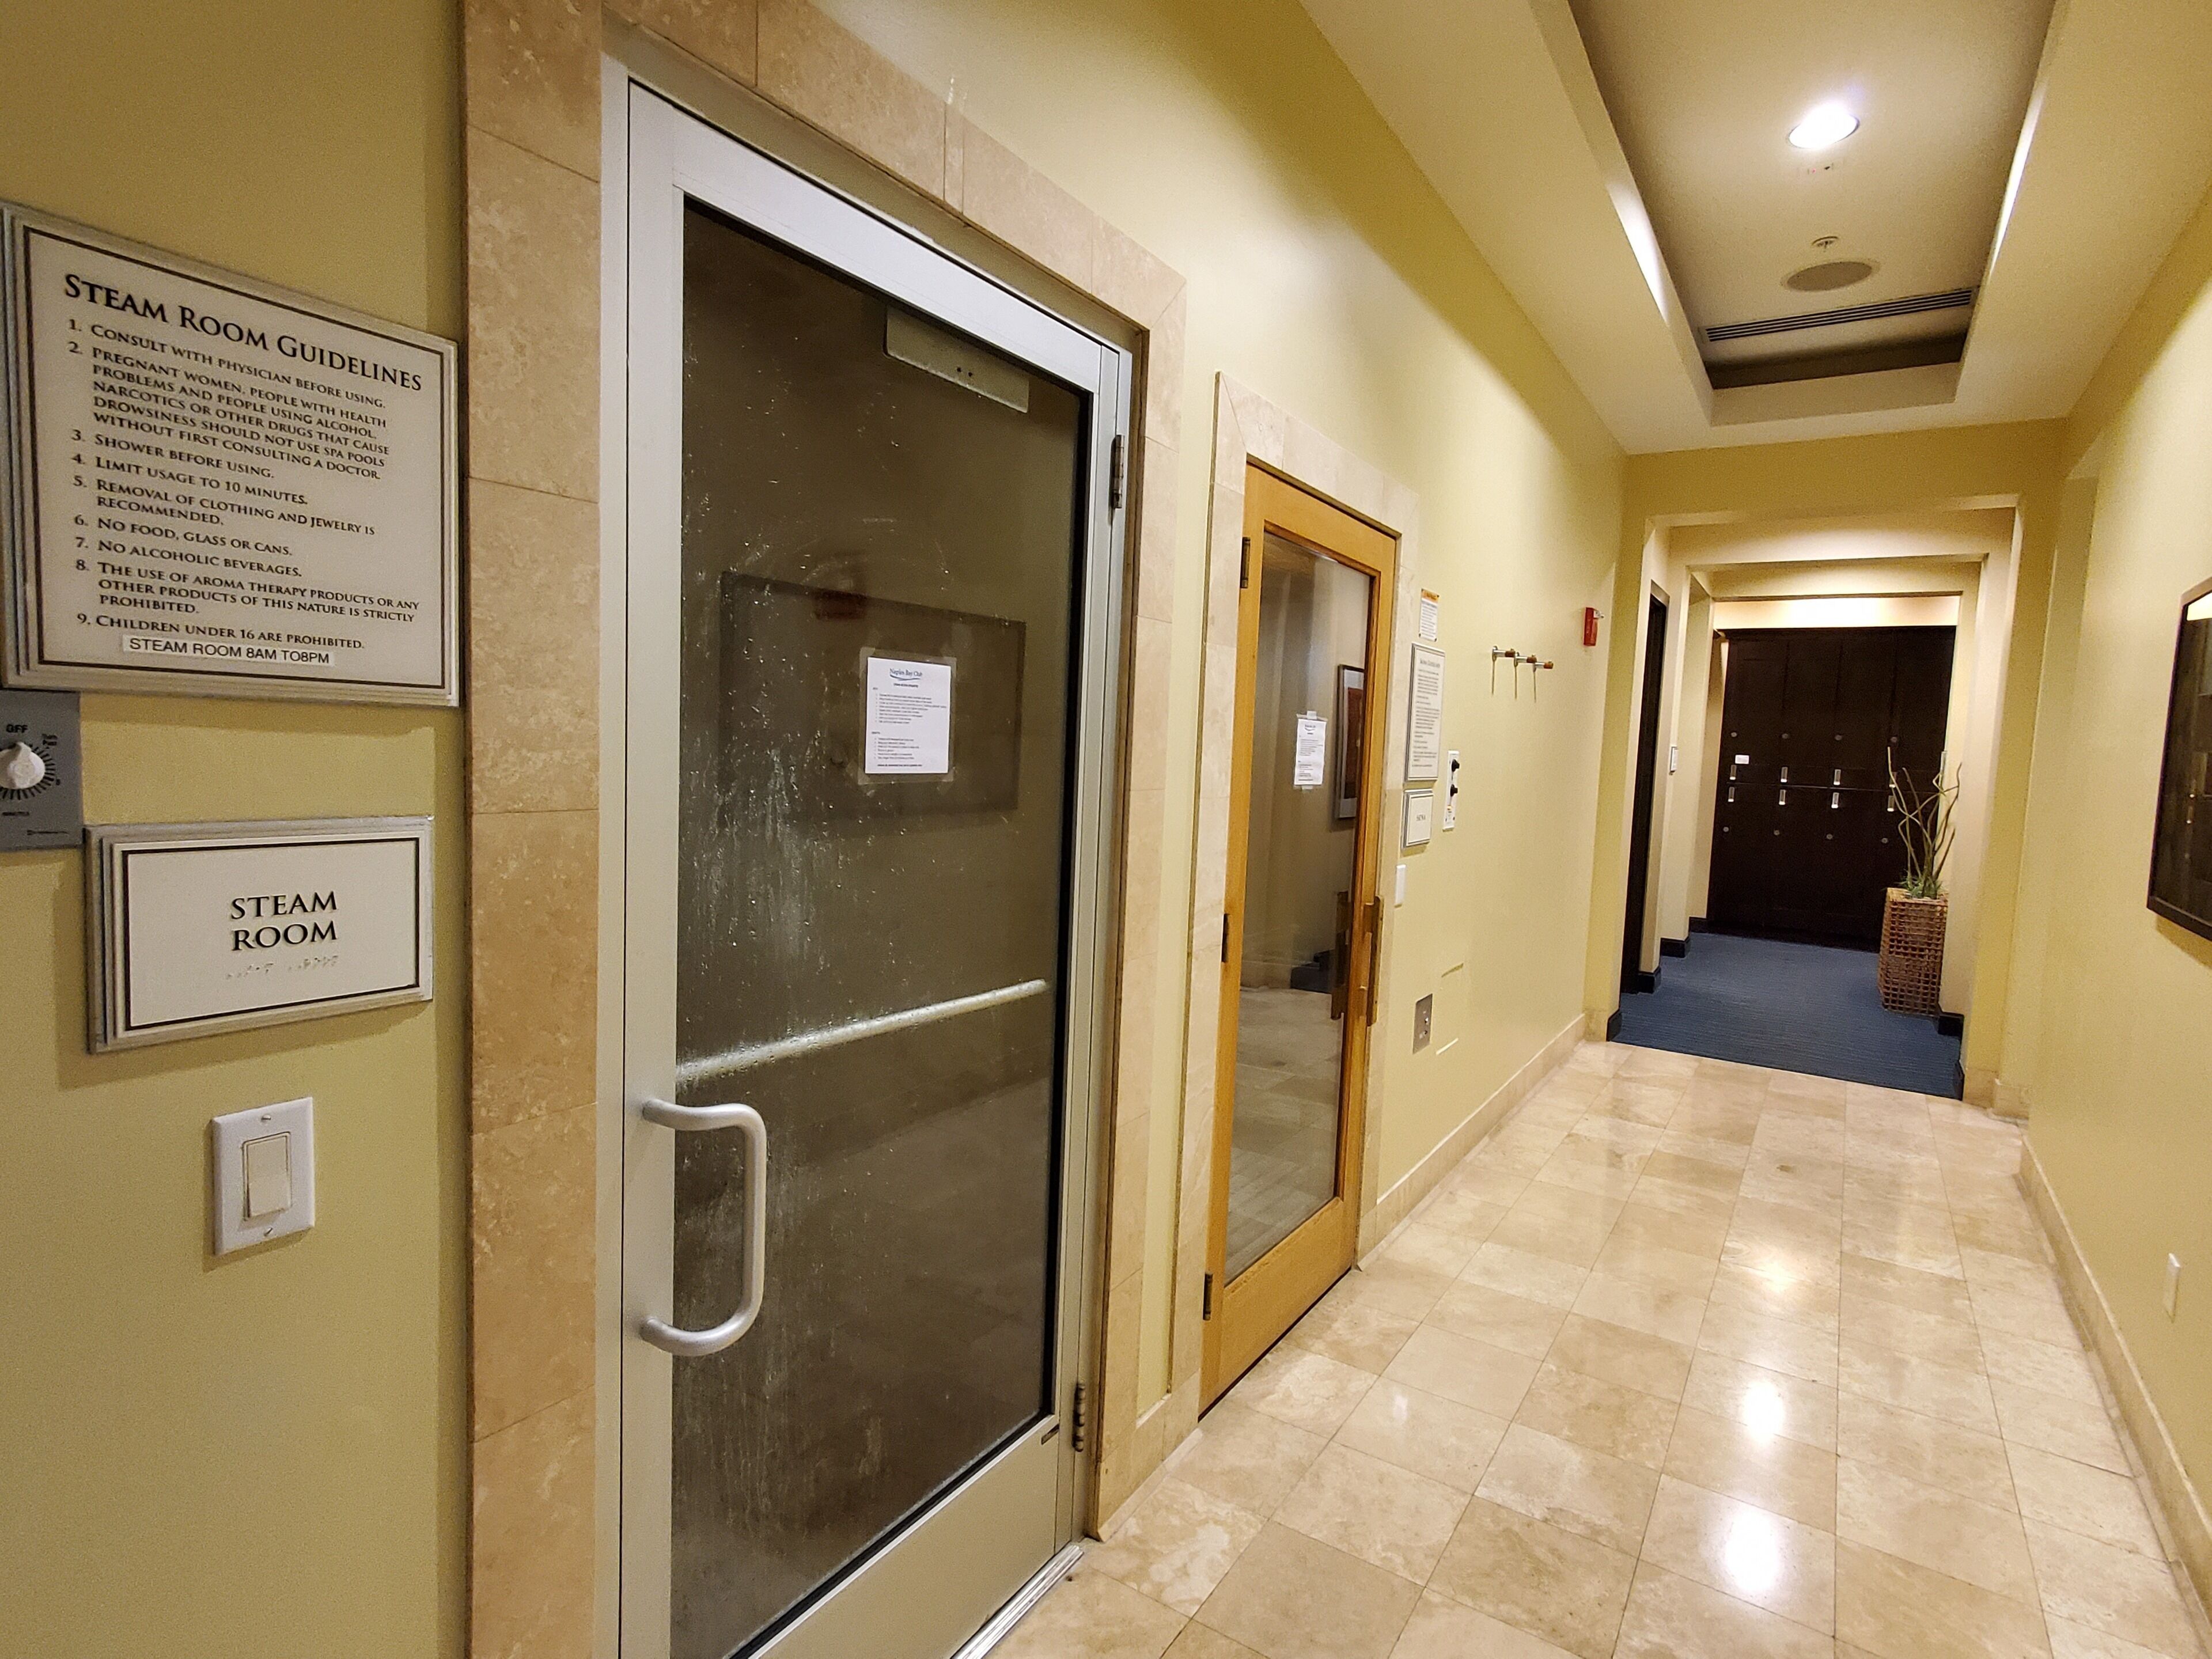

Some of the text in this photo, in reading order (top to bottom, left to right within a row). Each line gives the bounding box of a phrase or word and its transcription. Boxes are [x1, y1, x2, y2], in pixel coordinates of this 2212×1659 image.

[65, 273, 422, 391] STEAM ROOM GUIDELINES
[68, 341, 82, 354] 2.
[92, 347, 180, 378] PREGNANT
[250, 387, 298, 407] PEOPLE
[300, 399, 335, 416] WITH
[340, 409, 386, 428] HEALTH
[69, 319, 385, 408] 1. CONSULT WITH PHYSICIAN BEFORE USING.
[93, 364, 175, 392] PROBLEMS
[179, 385, 213, 401] AND
[217, 394, 266, 414] PEOPLE
[271, 407, 313, 425] USING
[93, 381, 389, 455] NARCOTICS OR OTHER DRUGS THAT CAUSE
[71, 429, 274, 479] 3. SHOWER BEFORE USING.
[93, 412, 174, 437] WITHOUT
[179, 430, 218, 446] FIRST
[222, 440, 312, 466] CONSULTING
[313, 459, 323, 468] A
[94, 396, 385, 467] DROWSINESS SHOULD NOT USE SPA POOLS
[71, 453, 308, 505] 4. LIMIT USAGE TO 10 MINUTES.
[73, 475, 375, 535] 5. REMOVAL OF CLOTHING AND JEWELRY IS
[74, 514, 292, 556] 6. NO FOOD, GLASS OR CANS.
[75, 536, 302, 577] 7. NO ALCOHOLIC BEVERAGES.
[75, 559, 419, 610] 8. THE USE OF AROMA THERAPY PRODUCTS OR ANY
[98, 579, 415, 623] OTHER PRODUCTS OF THIS NATURE IS STRICTLY
[99, 594, 199, 613] PROHIBITED.
[77, 613, 365, 649] 9. CHILDREN UNDER 16 ARE PROHIBITED.
[130, 638, 187, 653] STEAM
[193, 643, 241, 657] ROOM
[246, 647, 276, 660] 8AM
[6, 724, 28, 733] OFF
[231, 891, 337, 919] STEAM
[231, 921, 337, 951] ROOM
